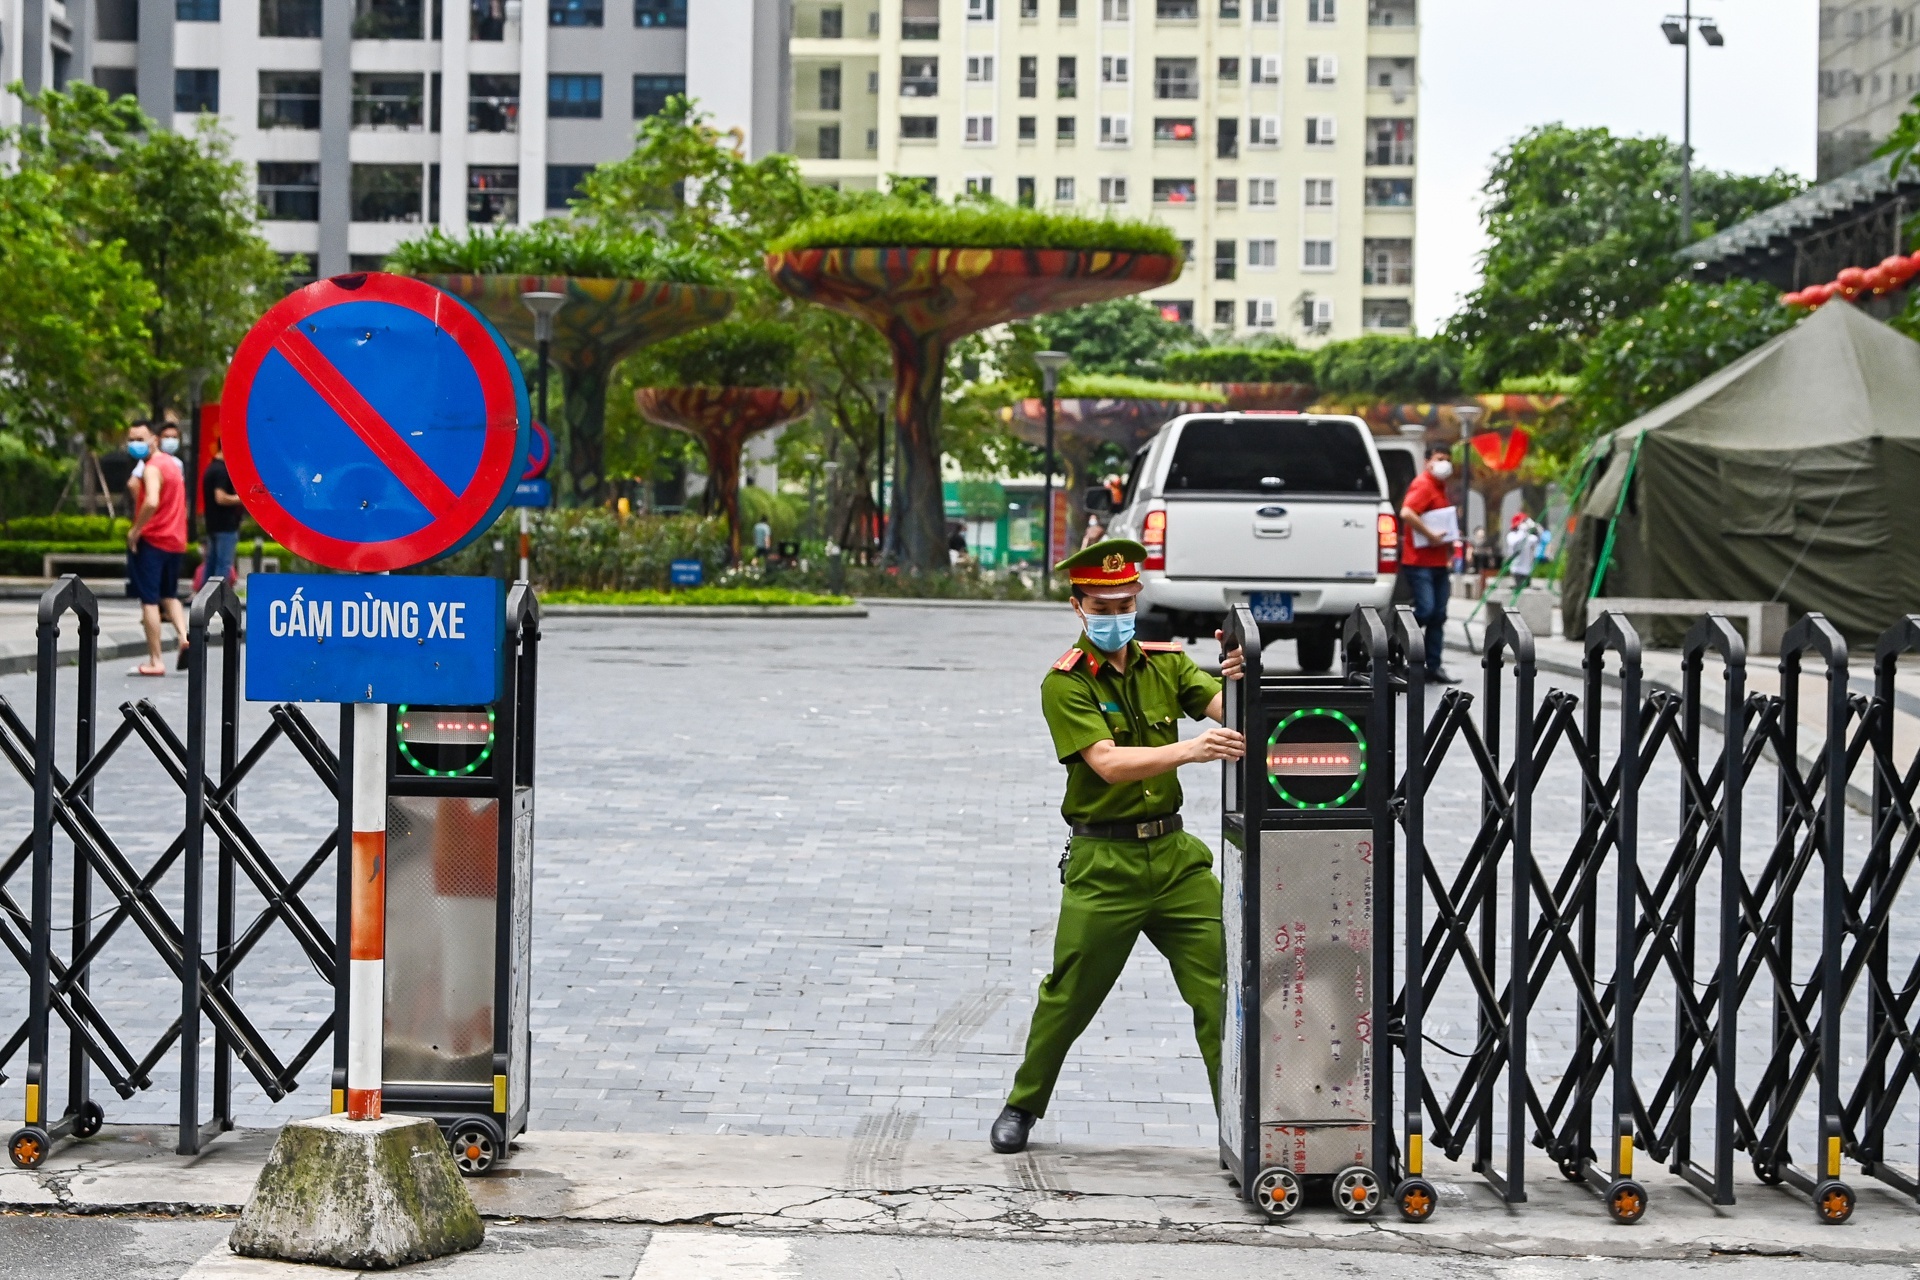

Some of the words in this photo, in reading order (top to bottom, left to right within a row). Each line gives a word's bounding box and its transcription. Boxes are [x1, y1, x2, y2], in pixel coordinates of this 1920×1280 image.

[269, 587, 333, 638] CẤM
[342, 592, 419, 639] DỪNG
[427, 602, 466, 639] XE
[1275, 923, 1290, 953] YCY
[1356, 1011, 1371, 1045] YCY
